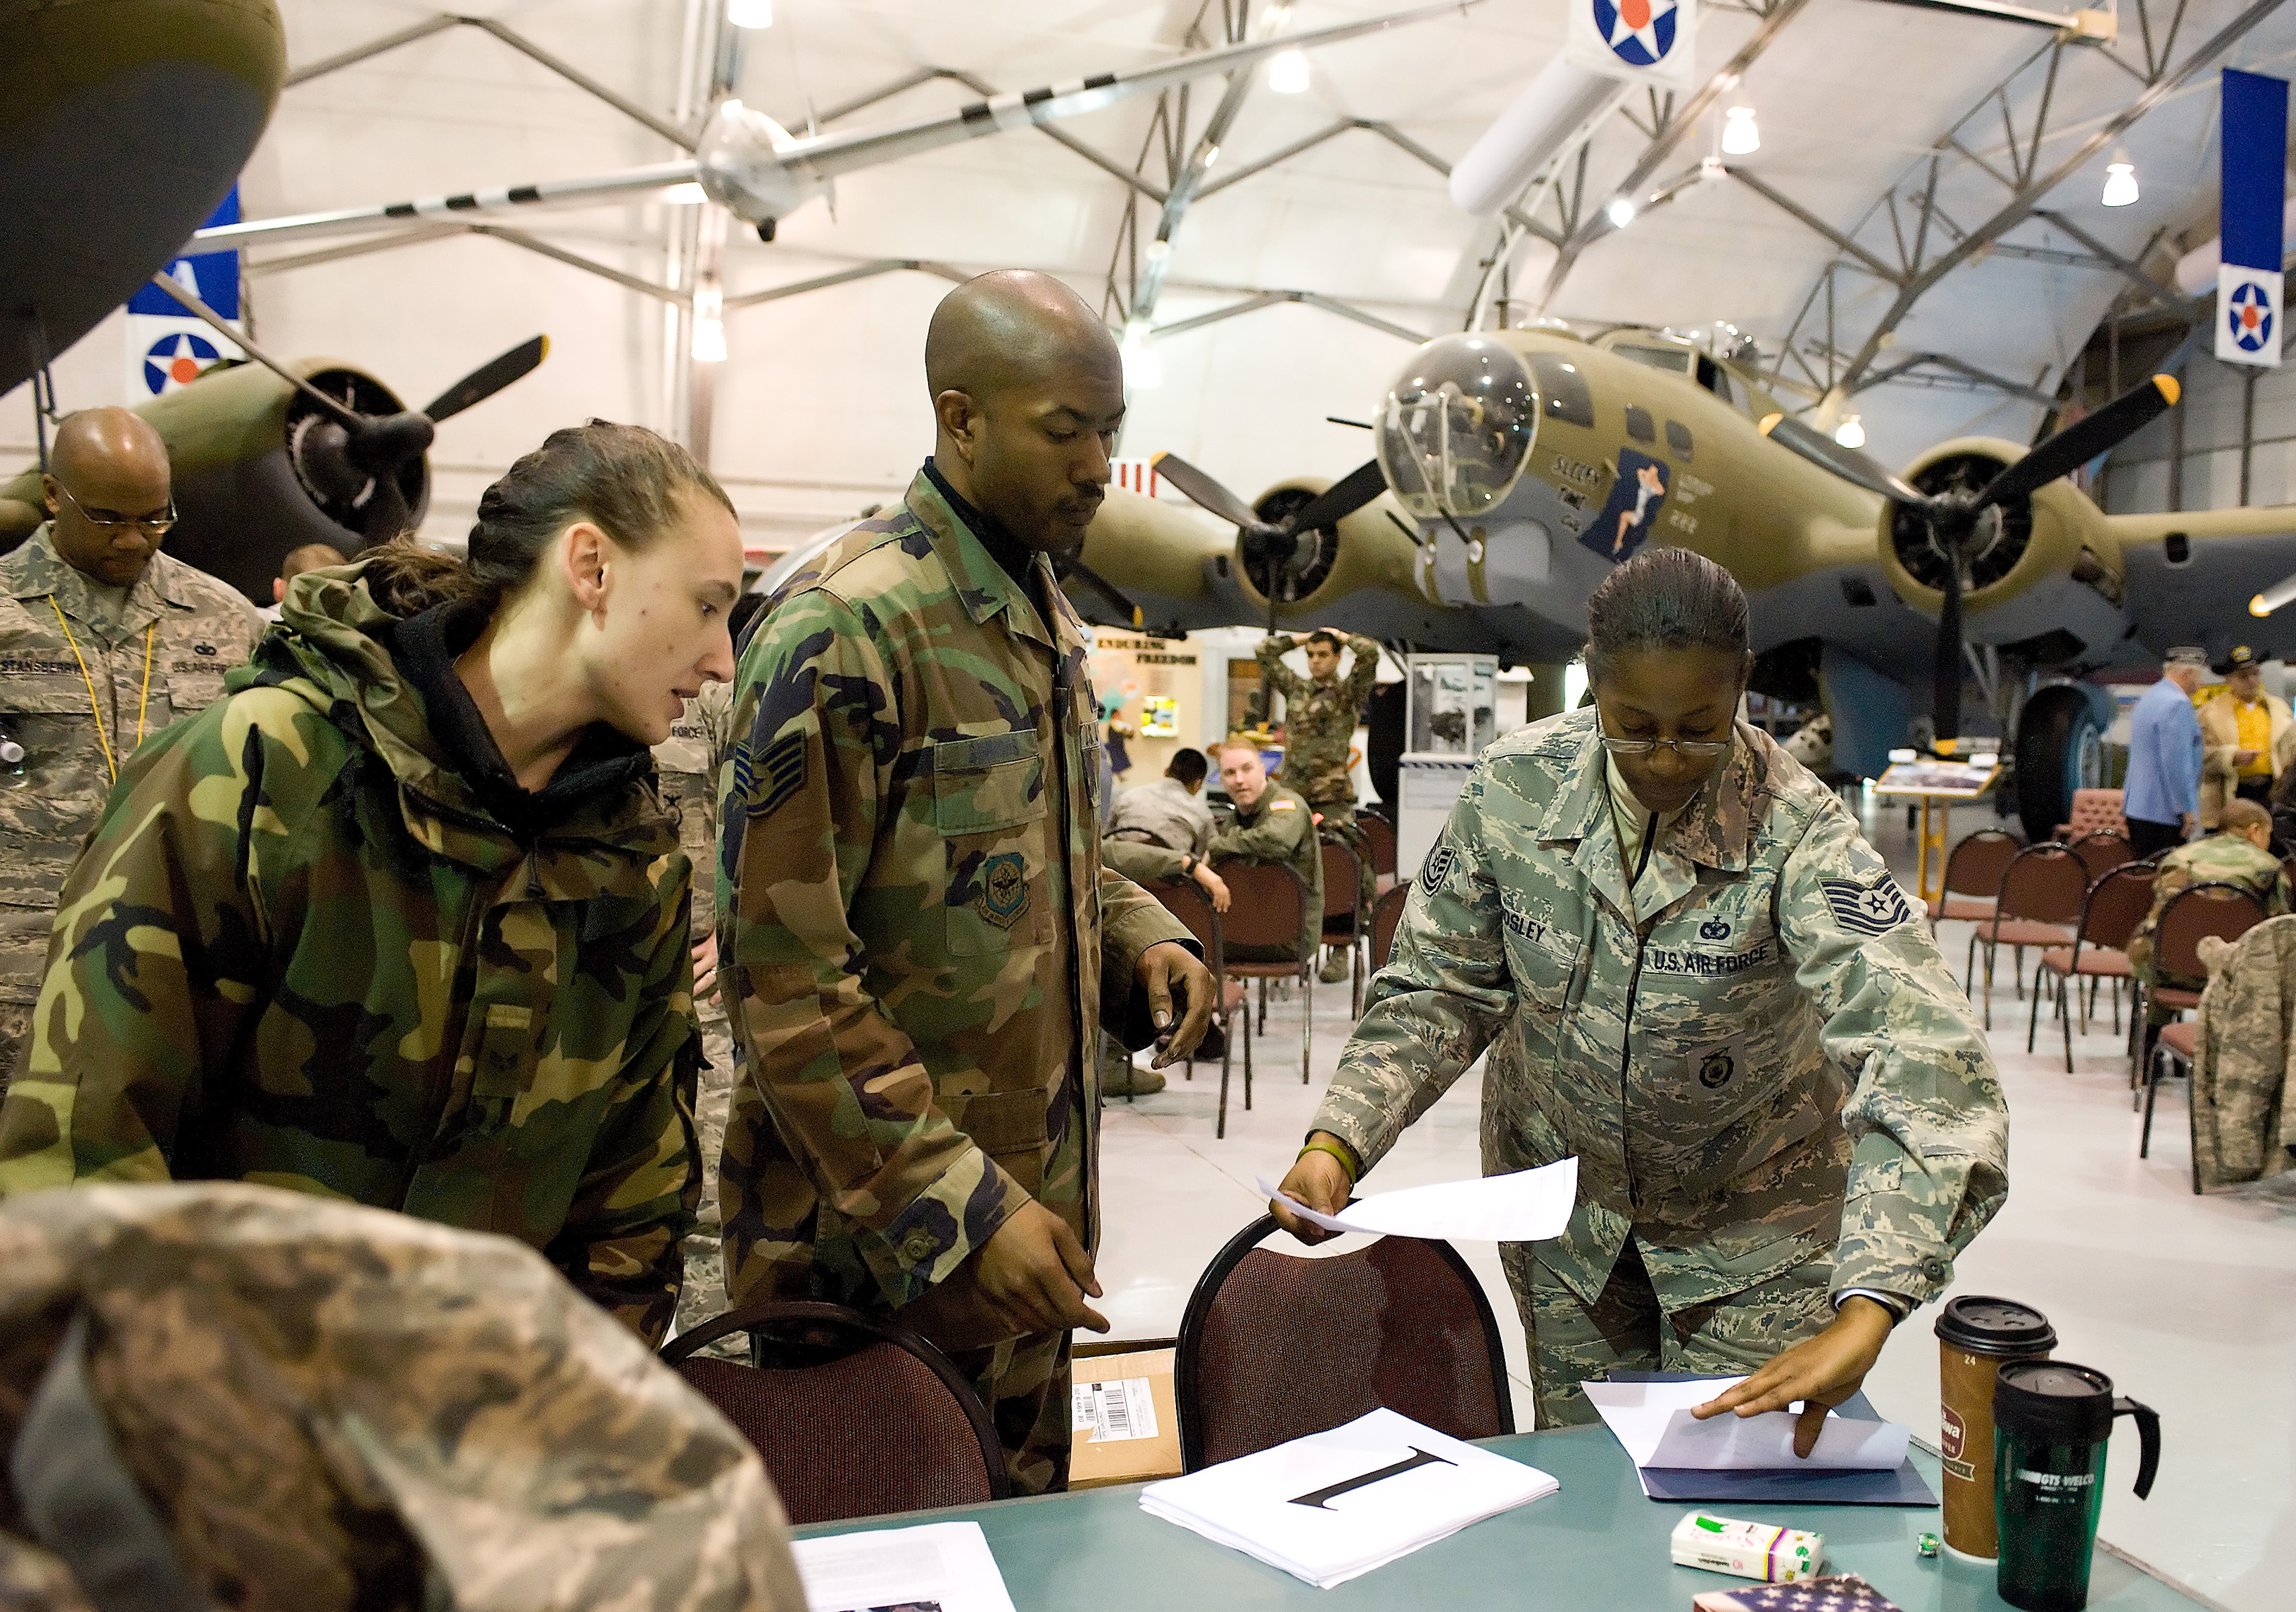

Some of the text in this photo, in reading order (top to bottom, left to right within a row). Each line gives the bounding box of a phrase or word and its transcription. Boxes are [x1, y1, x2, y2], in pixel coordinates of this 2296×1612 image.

[1136, 653, 1197, 666] FREEDOM
[672, 725, 703, 740] FORCE
[1503, 908, 1546, 943] OSLEY
[1654, 943, 1770, 975] U.S. AIR FORCE
[1964, 1354, 1976, 1367] 24
